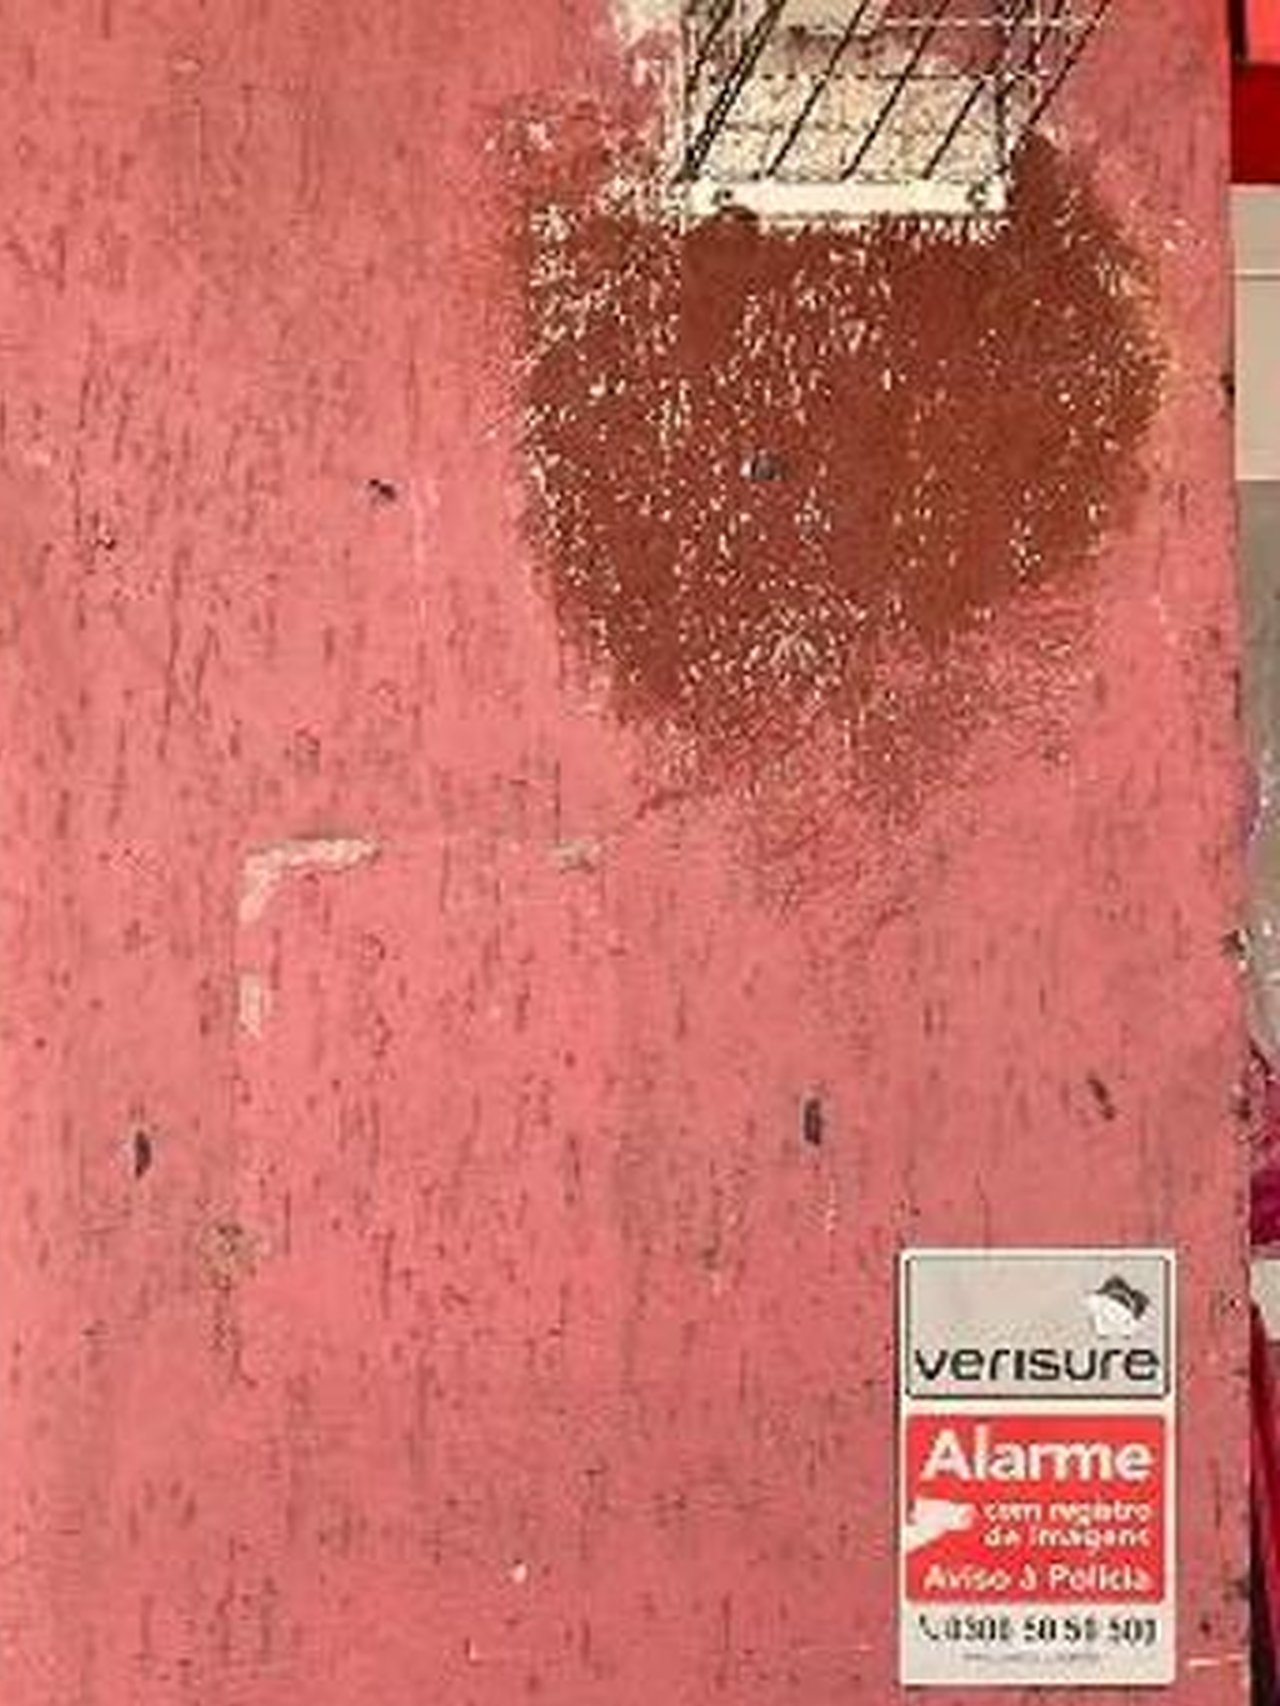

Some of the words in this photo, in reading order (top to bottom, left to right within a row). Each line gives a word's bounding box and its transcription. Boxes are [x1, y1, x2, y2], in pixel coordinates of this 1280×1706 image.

[914, 1347, 1160, 1381] verisure
[919, 1424, 1156, 1482] Alarme
[984, 1502, 1040, 1522] com
[1049, 1500, 1153, 1526] registro
[984, 1526, 1020, 1546] de
[923, 1564, 1011, 1592] Aviso
